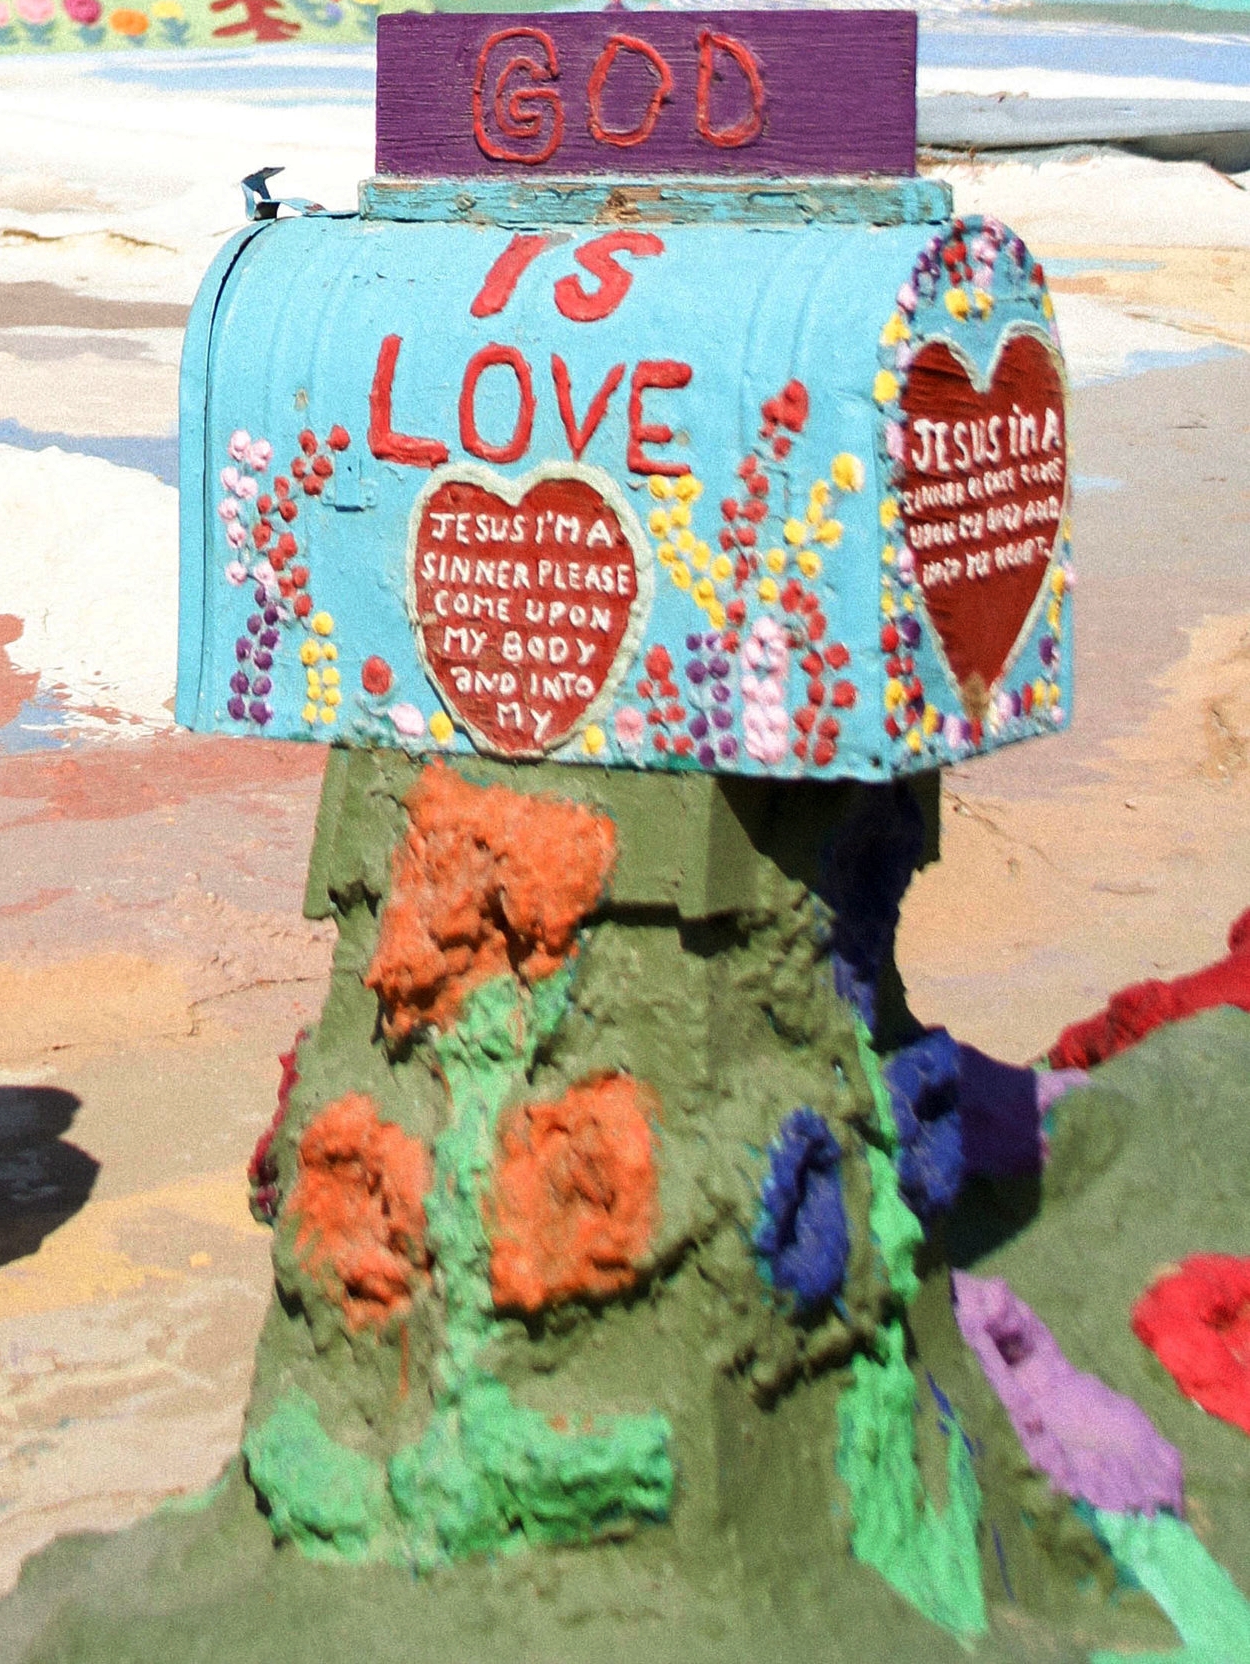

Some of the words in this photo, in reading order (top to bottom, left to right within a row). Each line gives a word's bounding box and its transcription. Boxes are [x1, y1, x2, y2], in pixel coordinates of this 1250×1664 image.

[471, 26, 766, 164] GOD
[469, 228, 667, 323] IS
[366, 332, 694, 478] LOVE
[911, 414, 1003, 474] JESUS
[429, 511, 528, 546] JESUS
[534, 509, 581, 545] I'M
[585, 518, 615, 550] A
[419, 550, 531, 590] SINNER
[536, 558, 632, 597] PLEASE
[433, 589, 512, 624] COME
[524, 598, 613, 633] UPON
[442, 625, 489, 658] MY
[501, 630, 597, 666] BODY
[529, 671, 596, 703] INTO
[495, 700, 554, 742] MY
